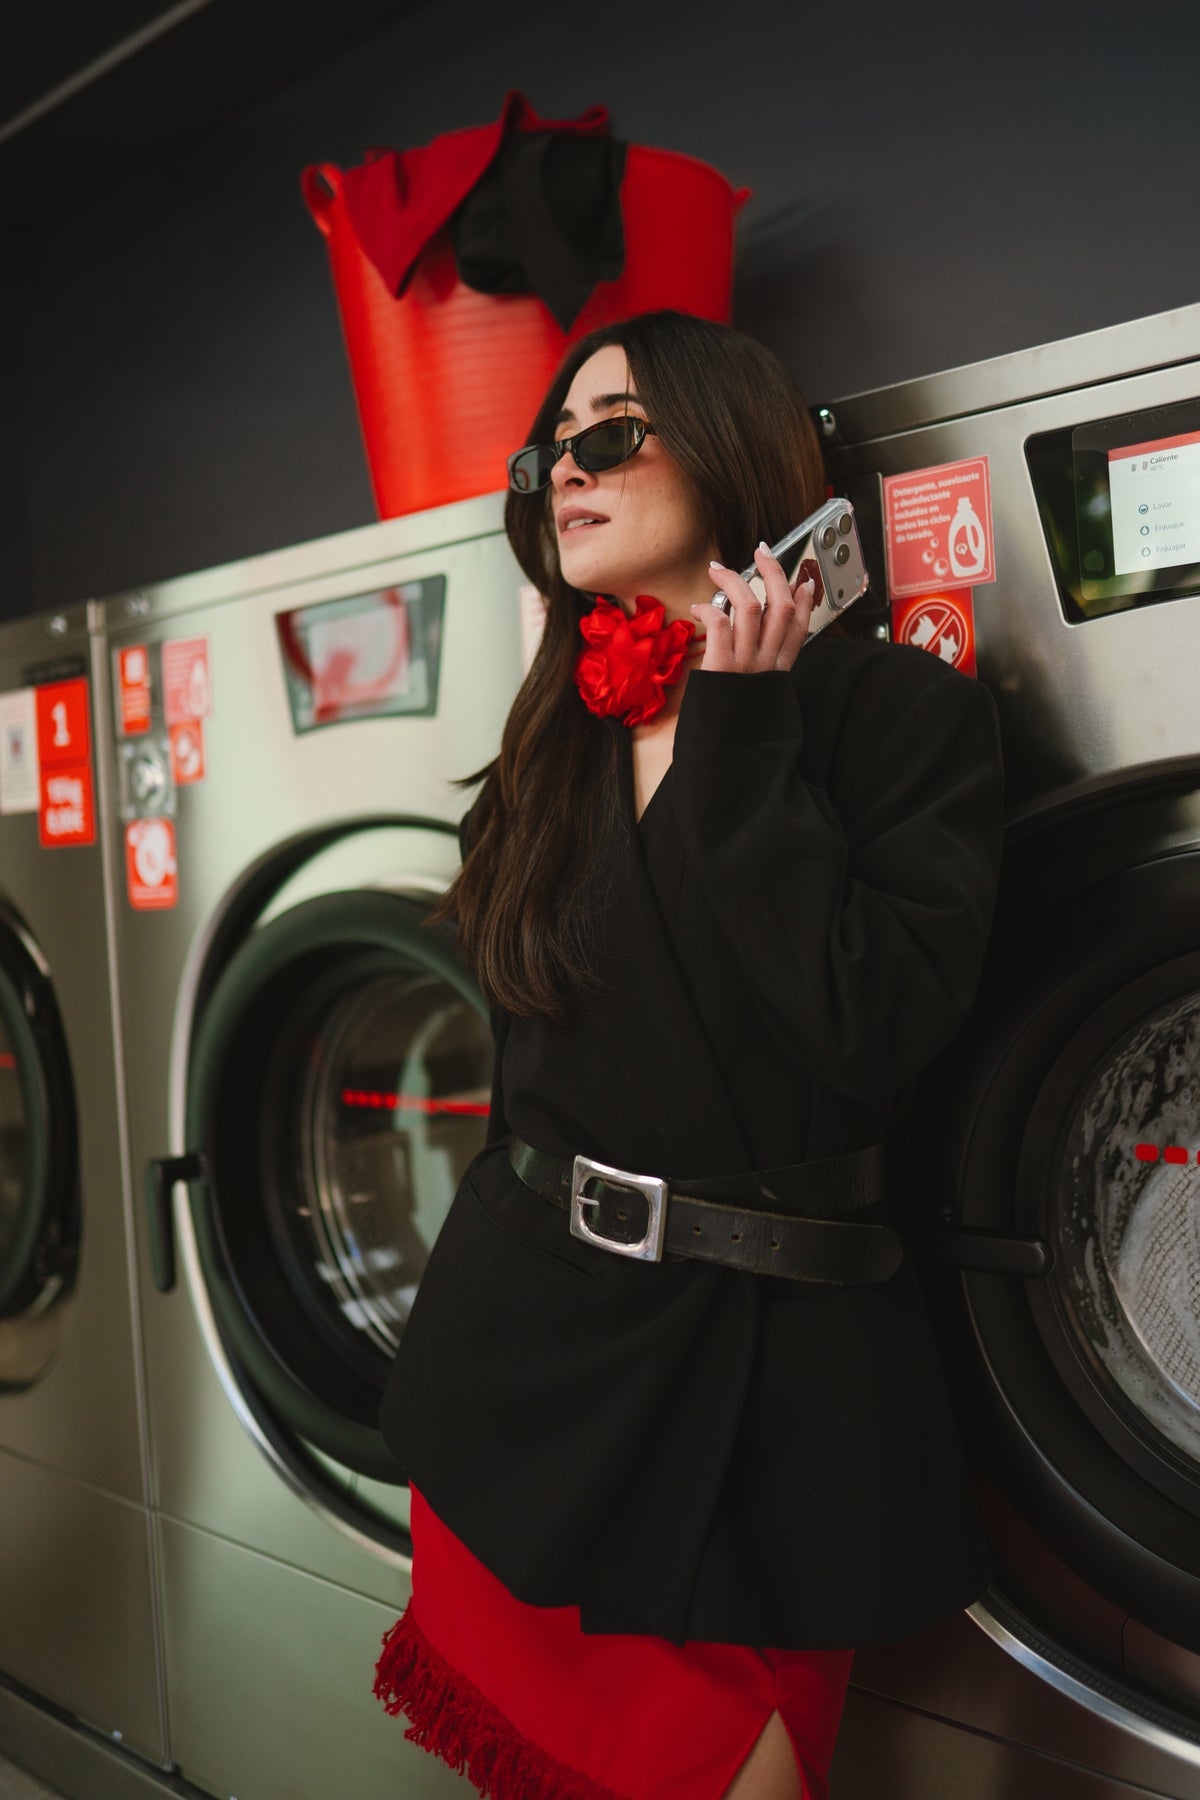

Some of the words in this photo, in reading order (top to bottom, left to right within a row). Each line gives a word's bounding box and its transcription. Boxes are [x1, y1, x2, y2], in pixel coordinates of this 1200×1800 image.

[1150, 454, 1178, 464] Caliente
[892, 482, 937, 498] Detergente,
[938, 472, 979, 488] suavizante
[899, 490, 951, 508] desinfectante
[929, 505, 939, 513] en
[1153, 501, 1172, 510] Lavar
[894, 521, 917, 532] todos
[929, 514, 951, 525] ciclos
[1154, 521, 1185, 532] Enjuagar
[1156, 543, 1186, 553] Enjuagar
[52, 700, 71, 747] 1
